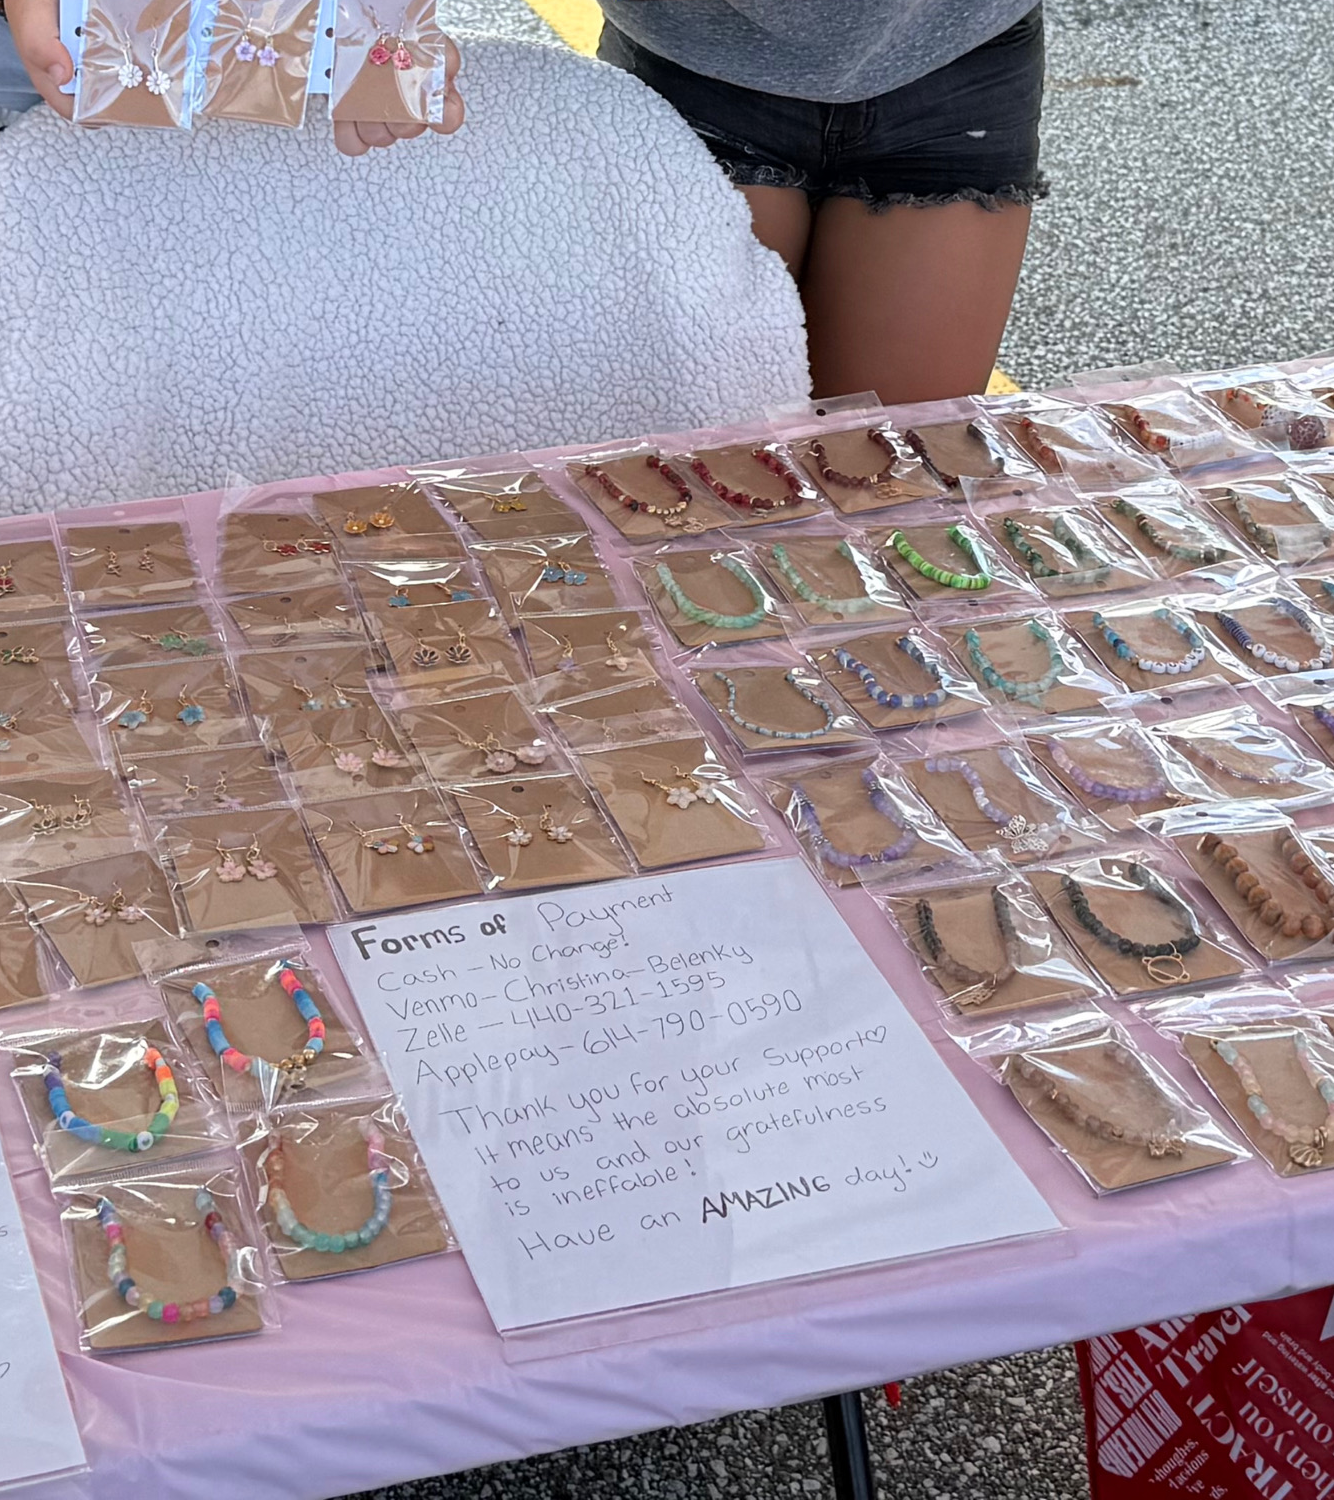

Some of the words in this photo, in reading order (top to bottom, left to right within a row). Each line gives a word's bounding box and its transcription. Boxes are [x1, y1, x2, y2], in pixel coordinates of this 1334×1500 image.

[351, 924, 466, 960] Forms
[480, 914, 506, 936] of
[538, 884, 673, 936] Payment
[377, 964, 457, 992] Cash
[490, 954, 521, 970] No
[532, 934, 629, 962] Change!
[397, 1022, 468, 1052] Zelle
[512, 971, 726, 1029] 440-321-1595
[438, 1095, 558, 1134] Thank
[567, 1084, 619, 1123] you
[630, 1072, 668, 1095] for
[681, 1056, 740, 1096] your
[507, 1125, 593, 1158] means
[613, 1110, 658, 1130] the
[674, 1080, 790, 1118] absolute
[803, 1064, 864, 1090] most
[491, 1176, 521, 1193] to
[540, 1166, 569, 1182] us
[597, 1140, 650, 1170] and
[665, 1134, 703, 1154] our
[727, 1097, 886, 1154] gratefulness
[505, 1200, 530, 1216] is
[518, 1223, 615, 1260] Have
[640, 1211, 681, 1230] an
[702, 1175, 830, 1223] AMAZING
[845, 1154, 912, 1192] day!
[1239, 1401, 1294, 1453] you
